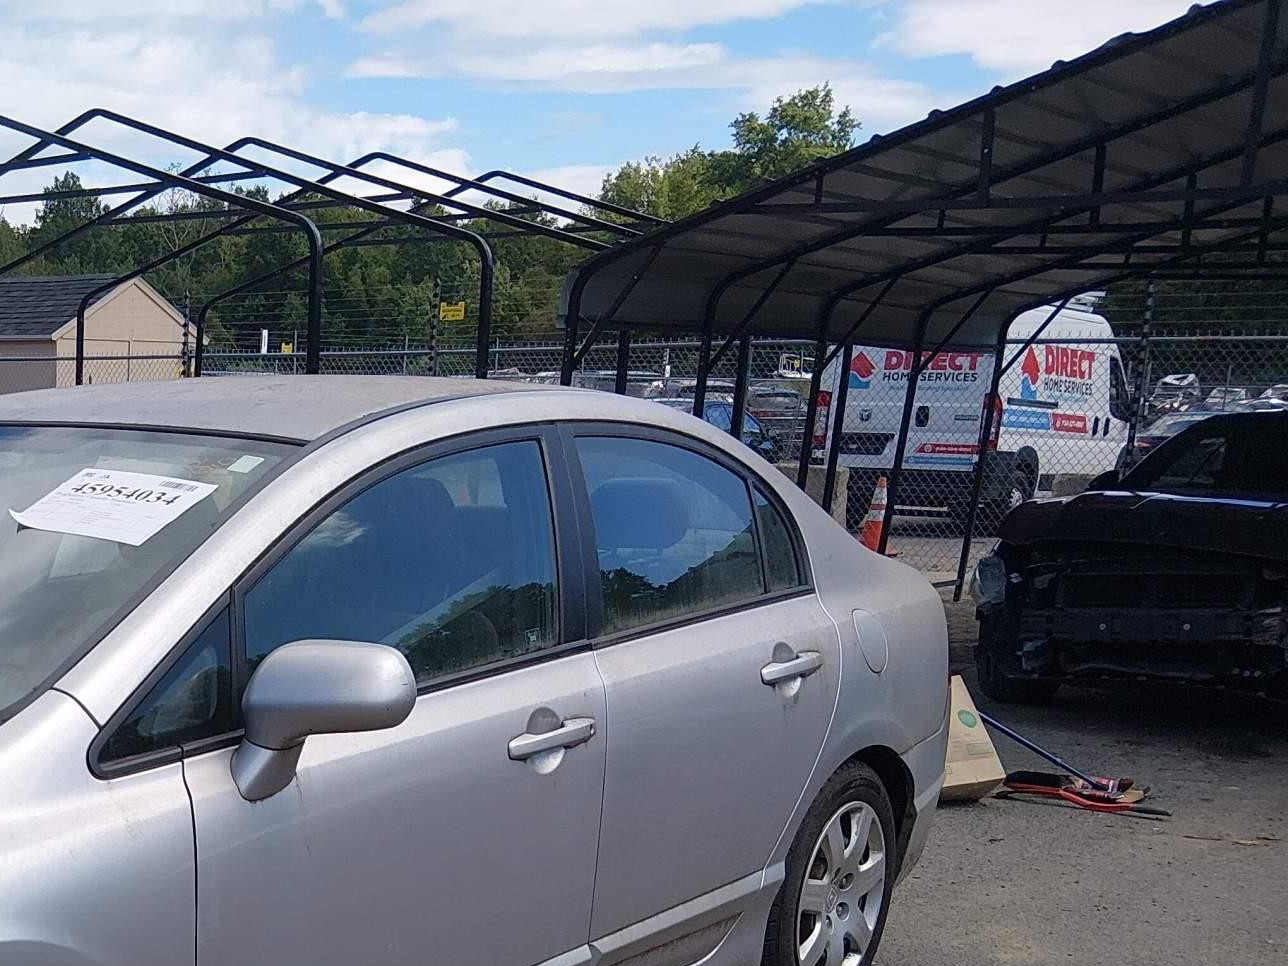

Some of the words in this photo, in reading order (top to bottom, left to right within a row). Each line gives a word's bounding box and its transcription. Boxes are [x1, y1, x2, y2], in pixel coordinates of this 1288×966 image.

[1045, 345, 1095, 379] DIRECT
[882, 372, 912, 382] HOM
[920, 372, 978, 383] SERVICES
[1044, 377, 1063, 393] HOME
[1064, 380, 1093, 396] SERVICES
[72, 482, 182, 506] 45954034
